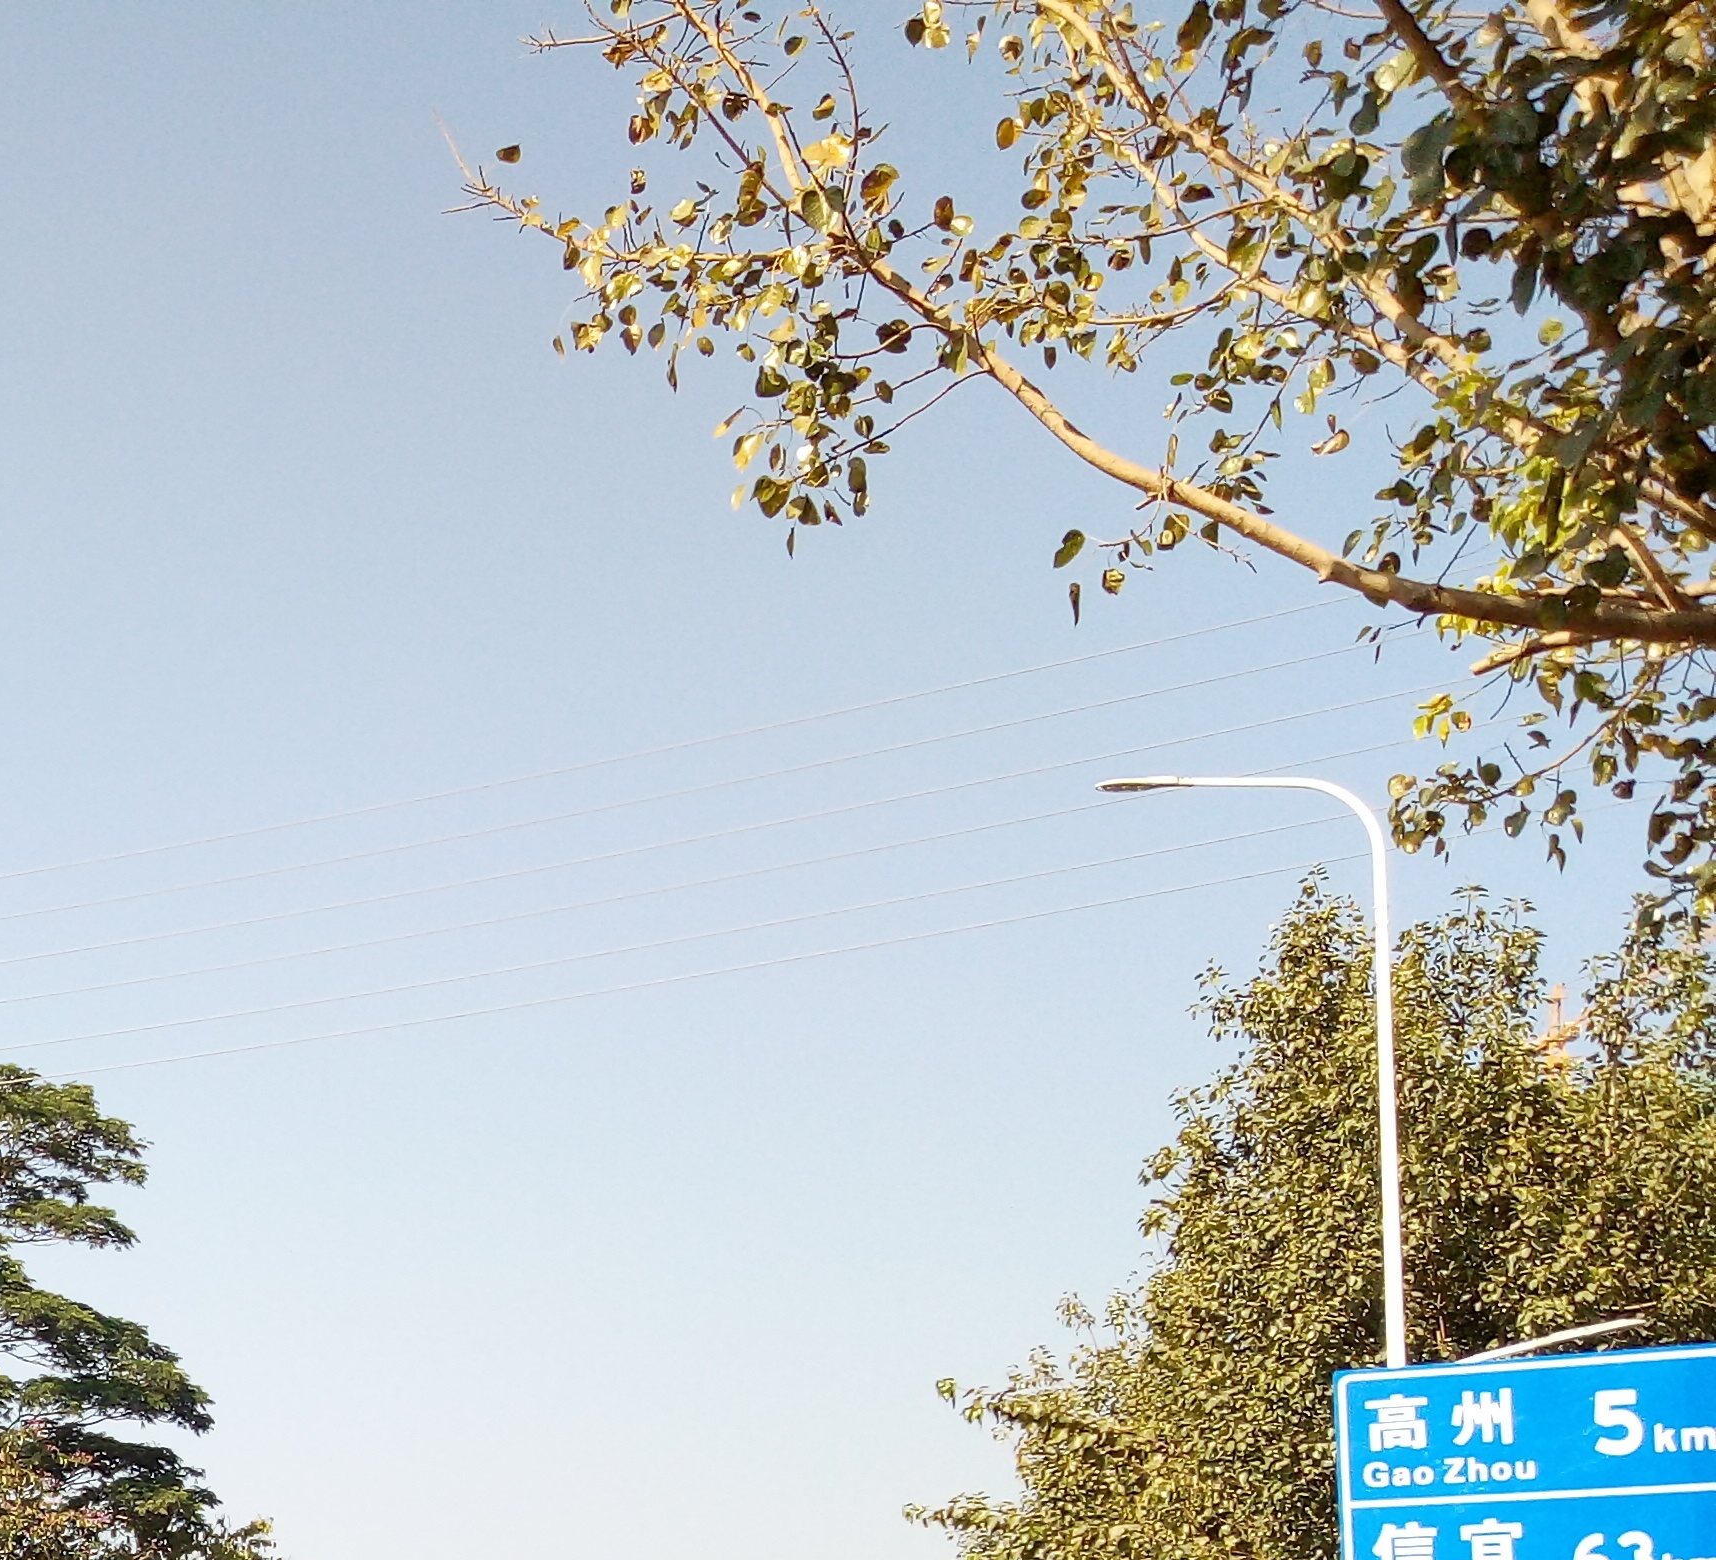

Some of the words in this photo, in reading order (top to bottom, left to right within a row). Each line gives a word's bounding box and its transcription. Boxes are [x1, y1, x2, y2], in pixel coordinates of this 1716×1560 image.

[1365, 1388, 1513, 1451] 高州
[1363, 1462, 1434, 1487] Gao
[1444, 1458, 1536, 1483] Zhou
